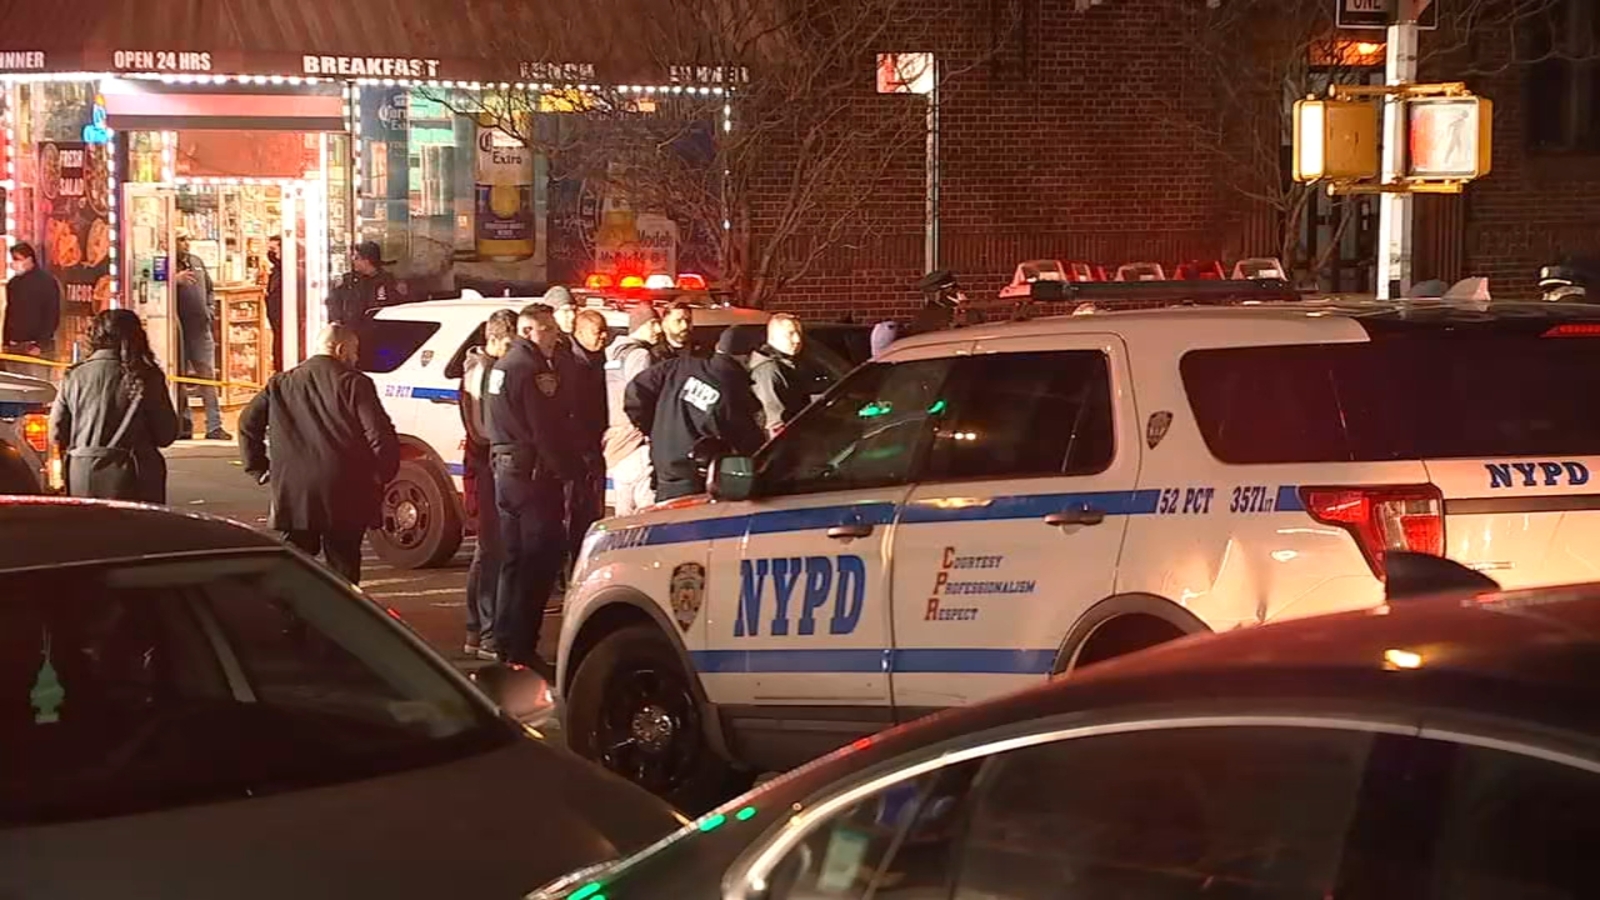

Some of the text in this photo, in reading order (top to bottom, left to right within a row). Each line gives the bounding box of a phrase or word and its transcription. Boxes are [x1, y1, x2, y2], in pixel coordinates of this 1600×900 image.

[114, 51, 211, 71] OPEN 24 HRS
[303, 55, 440, 77] BREAKFAST
[680, 376, 720, 405] NYPD
[1484, 462, 1589, 488] NYPD
[1160, 488, 1179, 514] 52
[1183, 487, 1214, 514] PCT
[733, 555, 866, 637] NYPD
